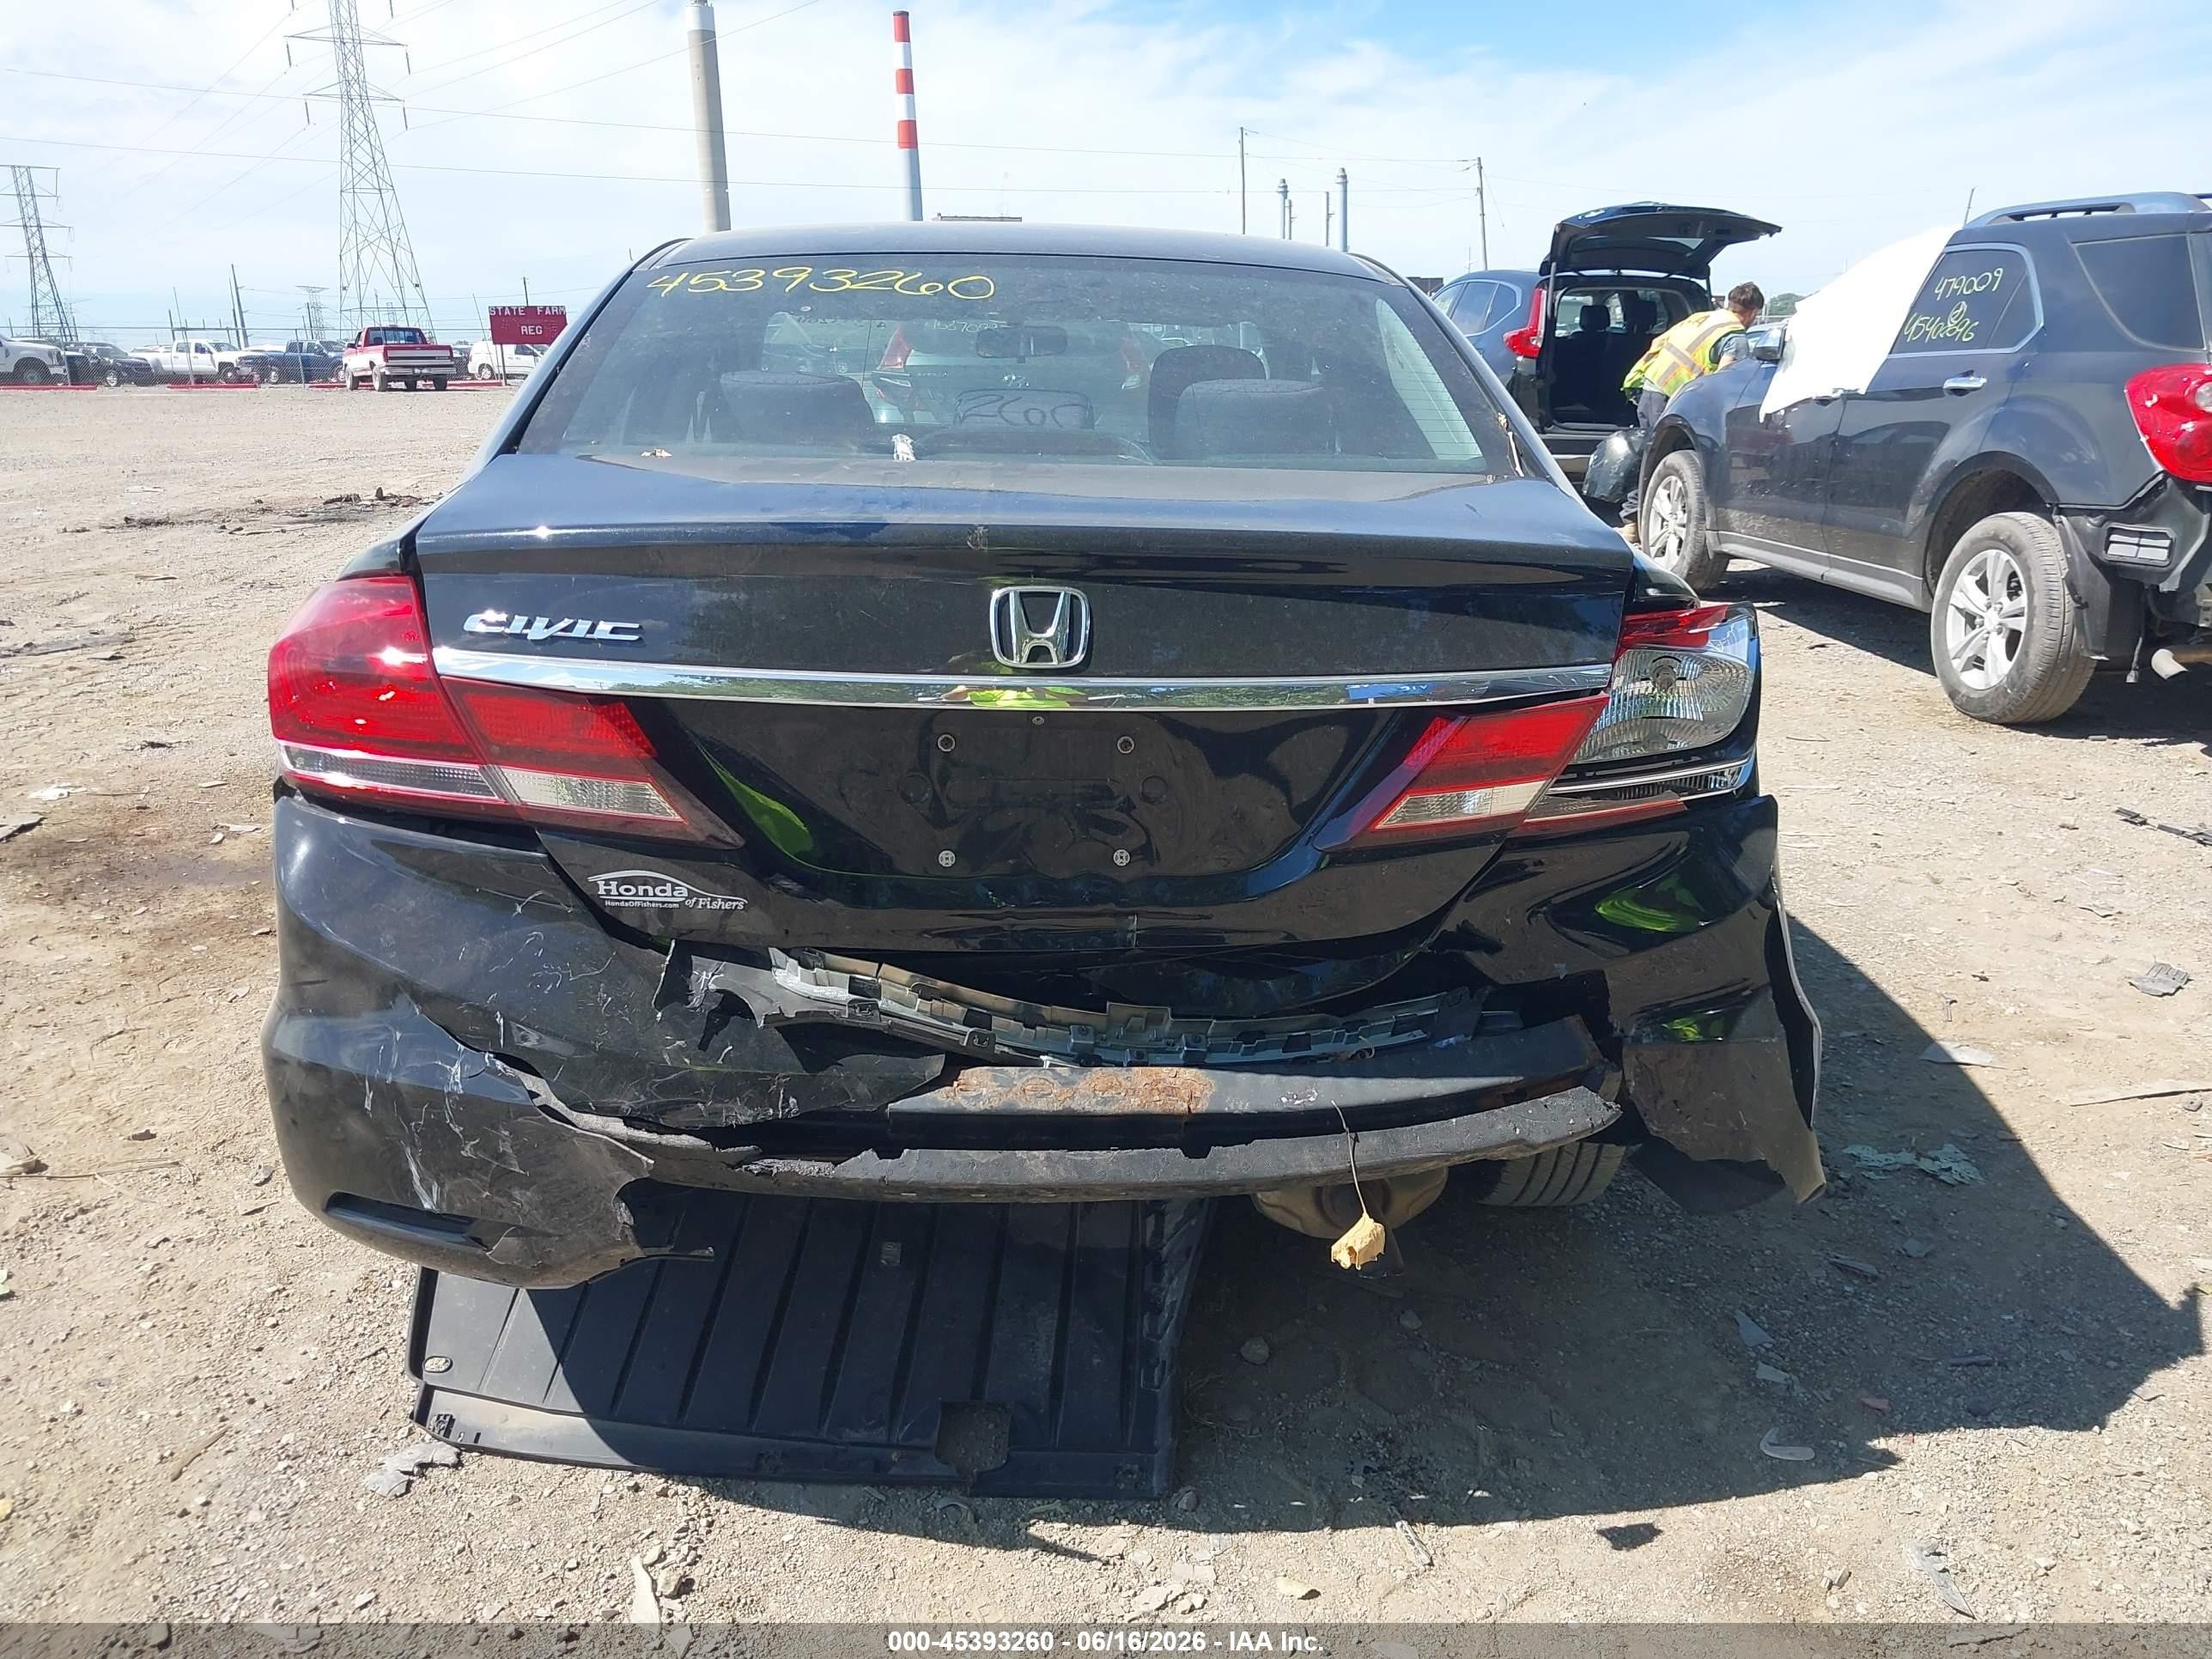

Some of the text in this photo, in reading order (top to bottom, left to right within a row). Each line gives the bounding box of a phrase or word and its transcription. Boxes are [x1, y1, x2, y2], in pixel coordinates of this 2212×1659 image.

[647, 266, 994, 299] 45393260
[1935, 267, 2003, 301] 479009
[489, 307, 566, 316] STATE FARM
[520, 325, 543, 335] REG
[463, 608, 641, 641] CIVIC
[596, 880, 745, 910] Honda of Fishers
